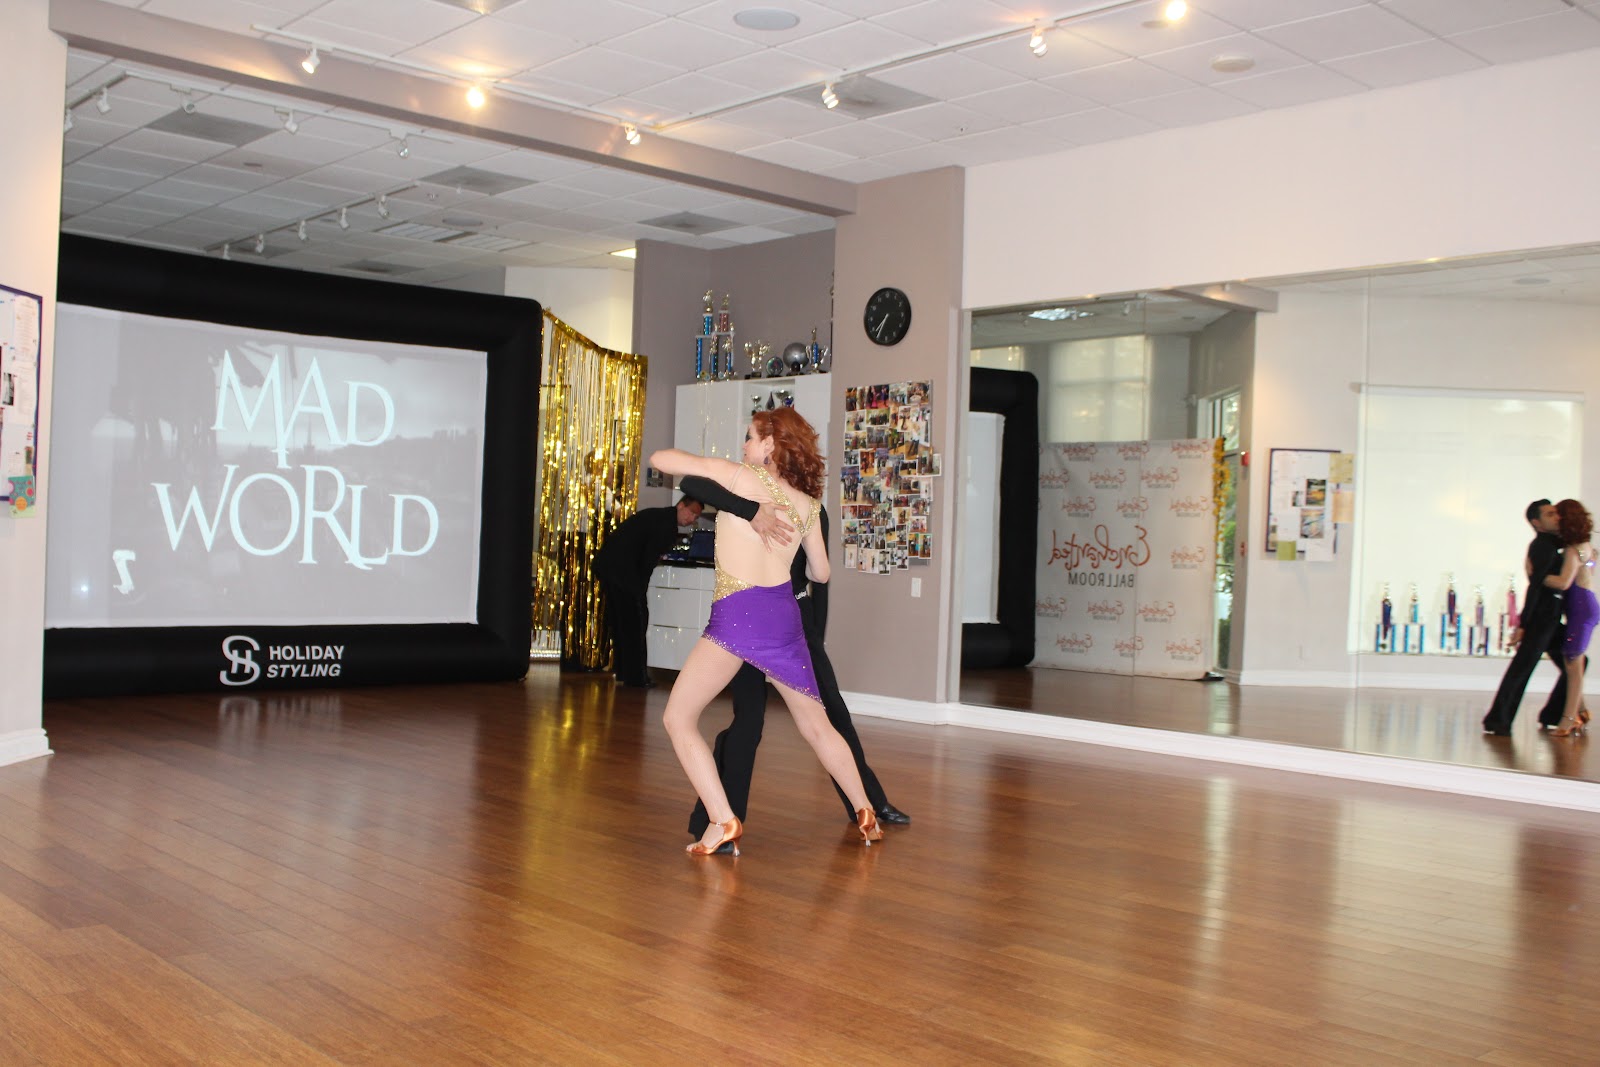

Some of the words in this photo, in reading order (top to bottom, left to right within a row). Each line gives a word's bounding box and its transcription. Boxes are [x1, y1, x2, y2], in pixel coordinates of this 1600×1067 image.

[210, 349, 395, 469] MAD
[151, 464, 439, 570] WORLD
[266, 663, 341, 679] STYLING
[269, 645, 345, 661] HOLIDAY
